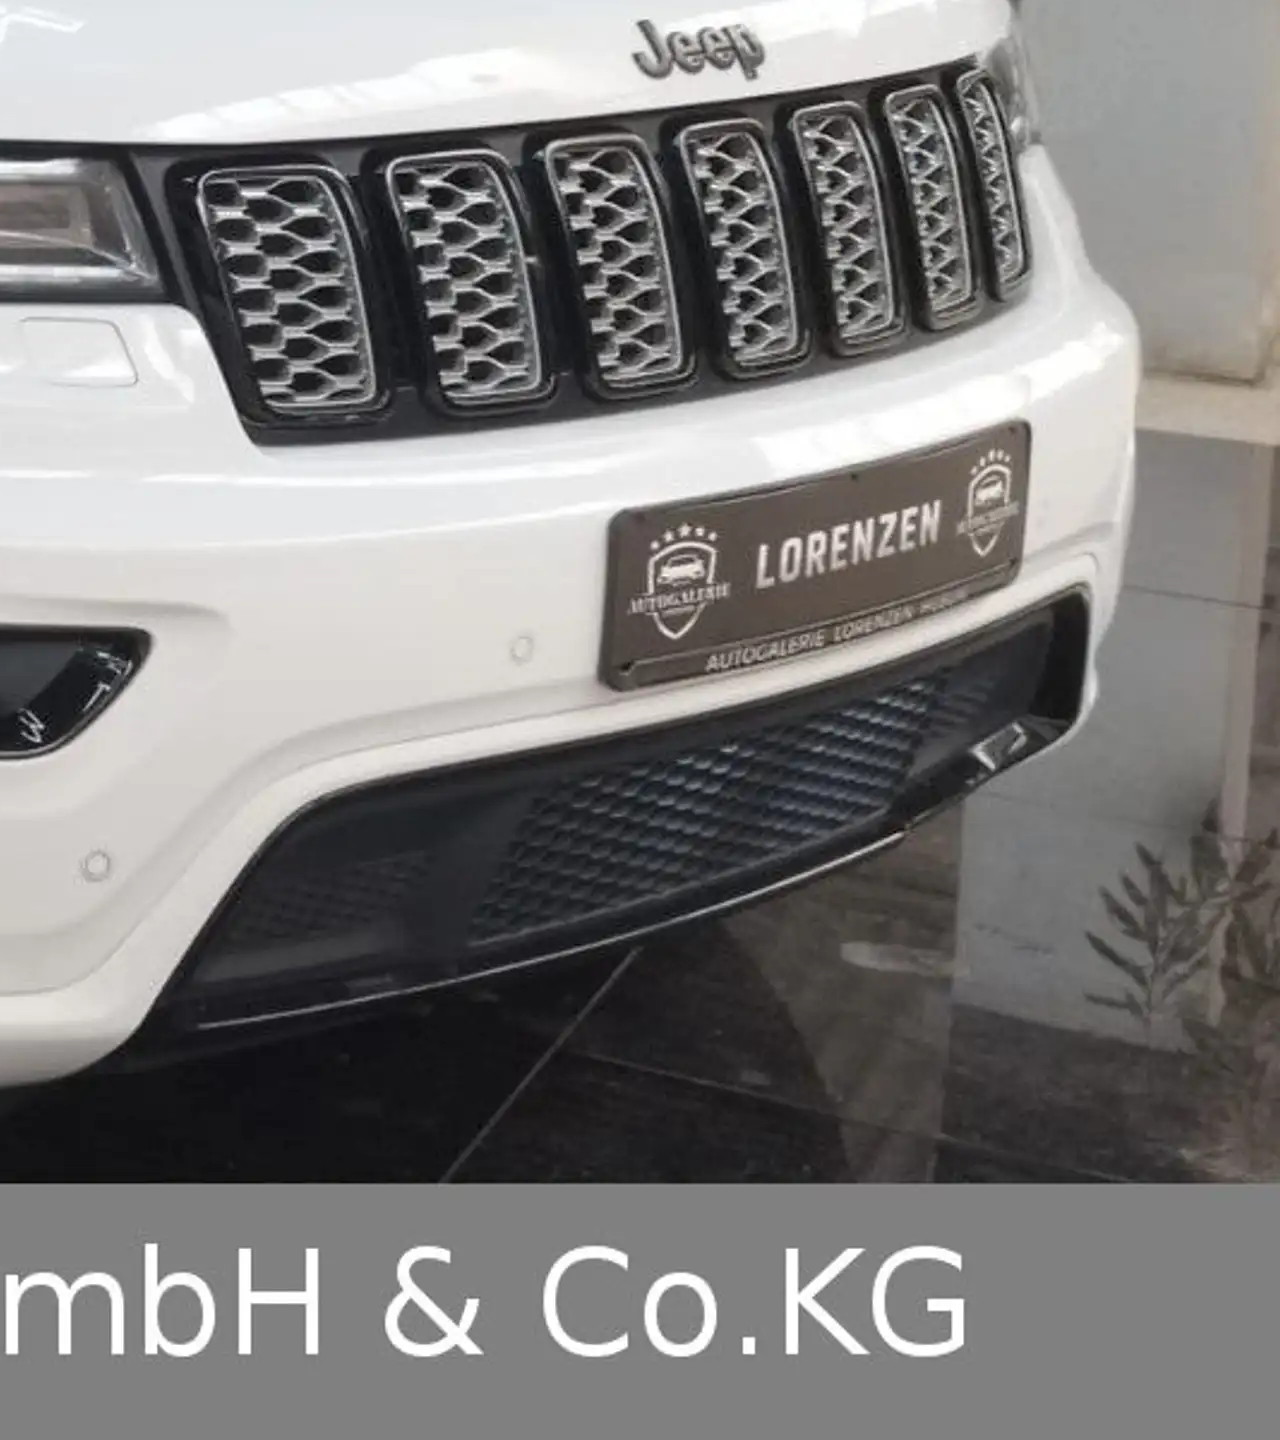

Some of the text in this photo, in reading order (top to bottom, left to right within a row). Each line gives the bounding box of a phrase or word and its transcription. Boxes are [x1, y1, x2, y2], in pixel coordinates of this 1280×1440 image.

[632, 19, 765, 81] Jeep
[756, 499, 941, 589] LORENZEN
[706, 628, 825, 672] AUTOGALERIE
